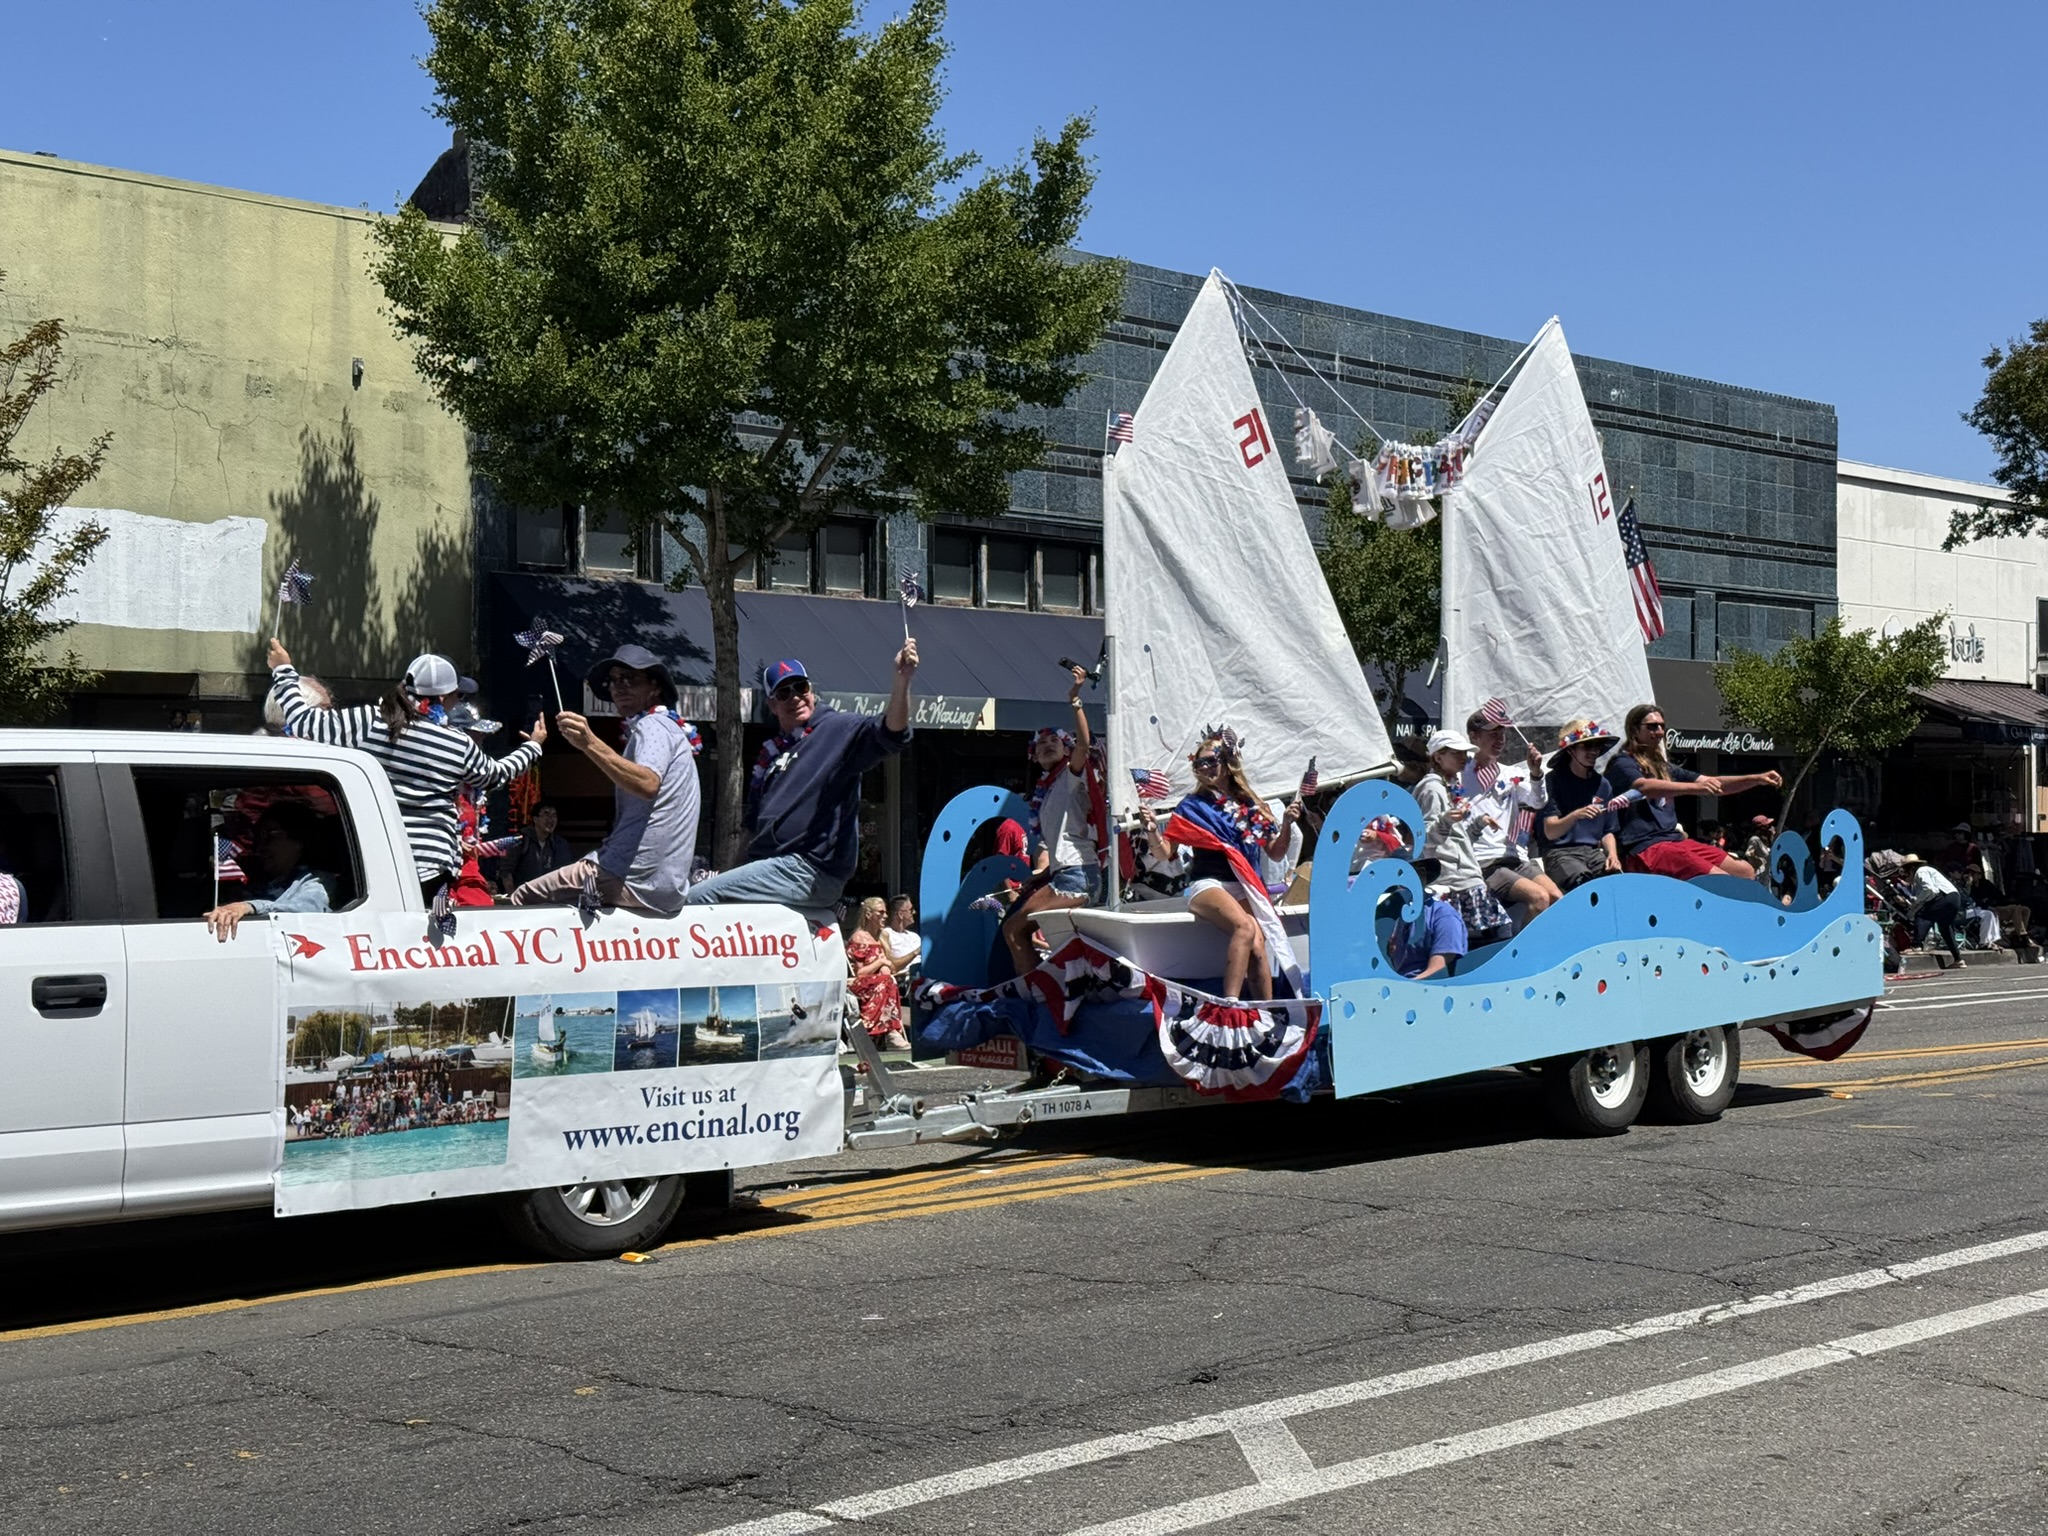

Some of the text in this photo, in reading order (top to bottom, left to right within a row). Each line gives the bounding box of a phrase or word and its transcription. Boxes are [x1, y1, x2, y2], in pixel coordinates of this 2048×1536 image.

[915, 699, 928, 724] &
[1665, 728, 1721, 753] Triumphant
[1741, 732, 1775, 752] Church
[343, 922, 799, 975] Encinal YC Junior Sailing
[639, 1086, 737, 1109] Visit us at
[1042, 1099, 1092, 1115] TH 1078 A
[562, 1102, 802, 1152] www.encinal.org
